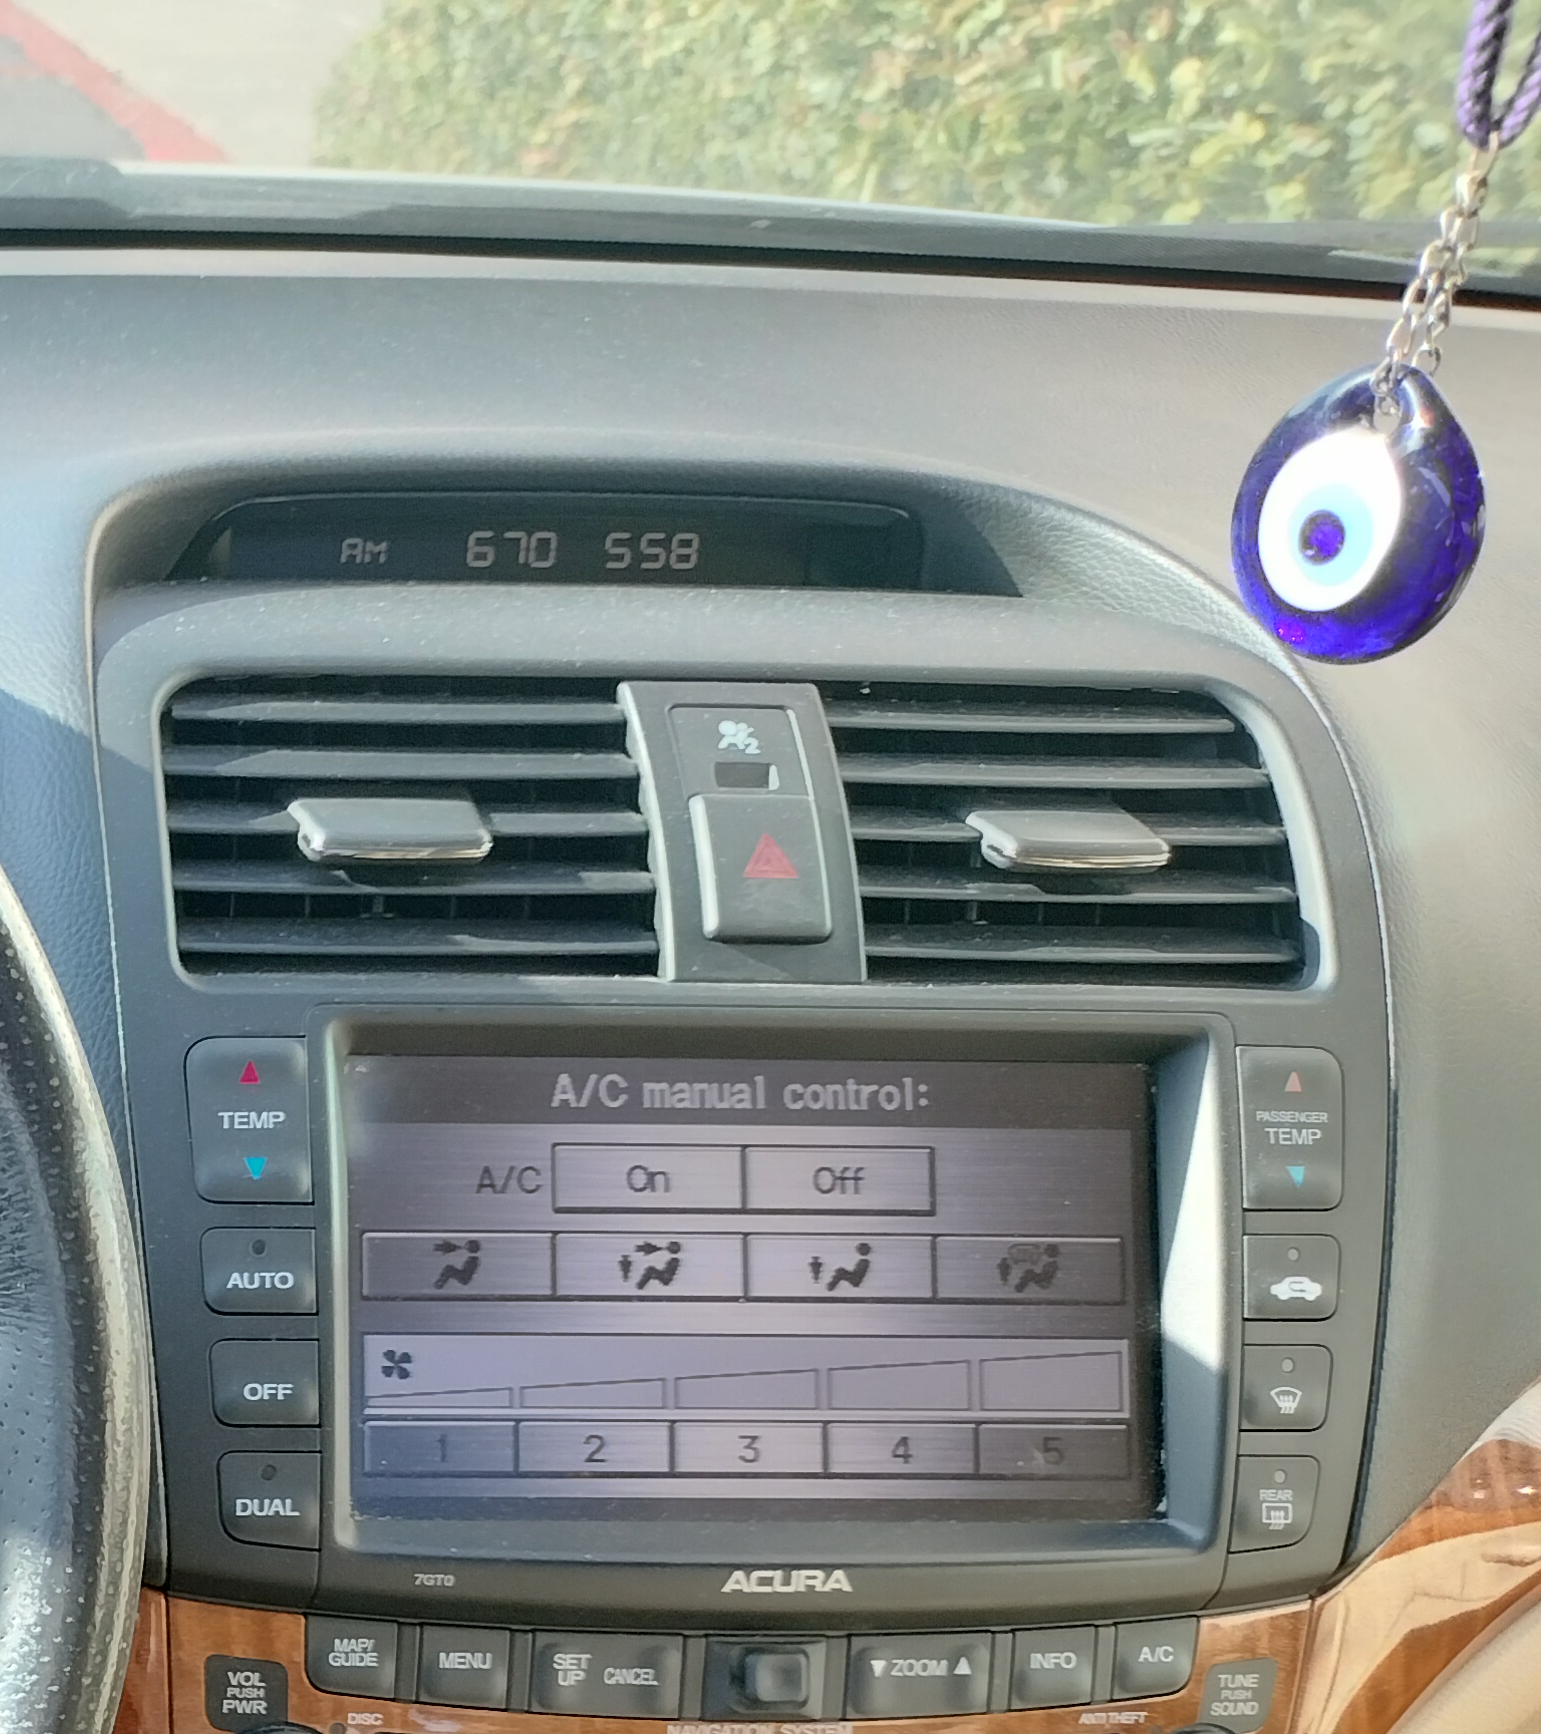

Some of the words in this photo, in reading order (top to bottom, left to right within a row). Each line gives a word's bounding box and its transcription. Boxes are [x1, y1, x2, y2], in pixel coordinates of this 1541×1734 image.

[340, 537, 390, 564] AM
[465, 530, 557, 568] 670
[604, 533, 701, 569] 558
[551, 1075, 628, 1110] A/C
[643, 1077, 767, 1111] manual
[783, 1077, 931, 1113] control:
[218, 1111, 286, 1130] TEMP
[1256, 1111, 1328, 1124] PASSENGER
[1265, 1128, 1322, 1145] TEMP
[475, 1164, 544, 1195] A/C
[626, 1164, 671, 1194] On
[813, 1166, 867, 1196] Off
[226, 1271, 295, 1289] AUTO
[243, 1384, 293, 1400] OFF
[583, 1435, 608, 1464] 2
[737, 1435, 761, 1465] 3
[890, 1436, 915, 1465] 4
[1041, 1437, 1066, 1467] 5
[1259, 1489, 1293, 1501] REAR
[235, 1499, 301, 1516] DUAL
[721, 1569, 854, 1594] ACURA
[334, 1638, 375, 1653] MAP/
[1138, 1645, 1175, 1663] A/C
[328, 1652, 378, 1669] GUIDE
[439, 1652, 493, 1670] MENU
[553, 1653, 592, 1670] SET
[890, 1658, 948, 1677] ZOOM
[1030, 1652, 1077, 1670] INFO
[227, 1671, 266, 1688] VOL
[557, 1670, 586, 1686] UP
[604, 1667, 659, 1686] CANCEL
[1218, 1674, 1259, 1689] TUNE
[227, 1688, 265, 1700] PUSH
[1220, 1689, 1252, 1701] PUSH
[222, 1700, 267, 1716] PWR
[1211, 1701, 1259, 1717] SOUND
[347, 1712, 383, 1726] DISC
